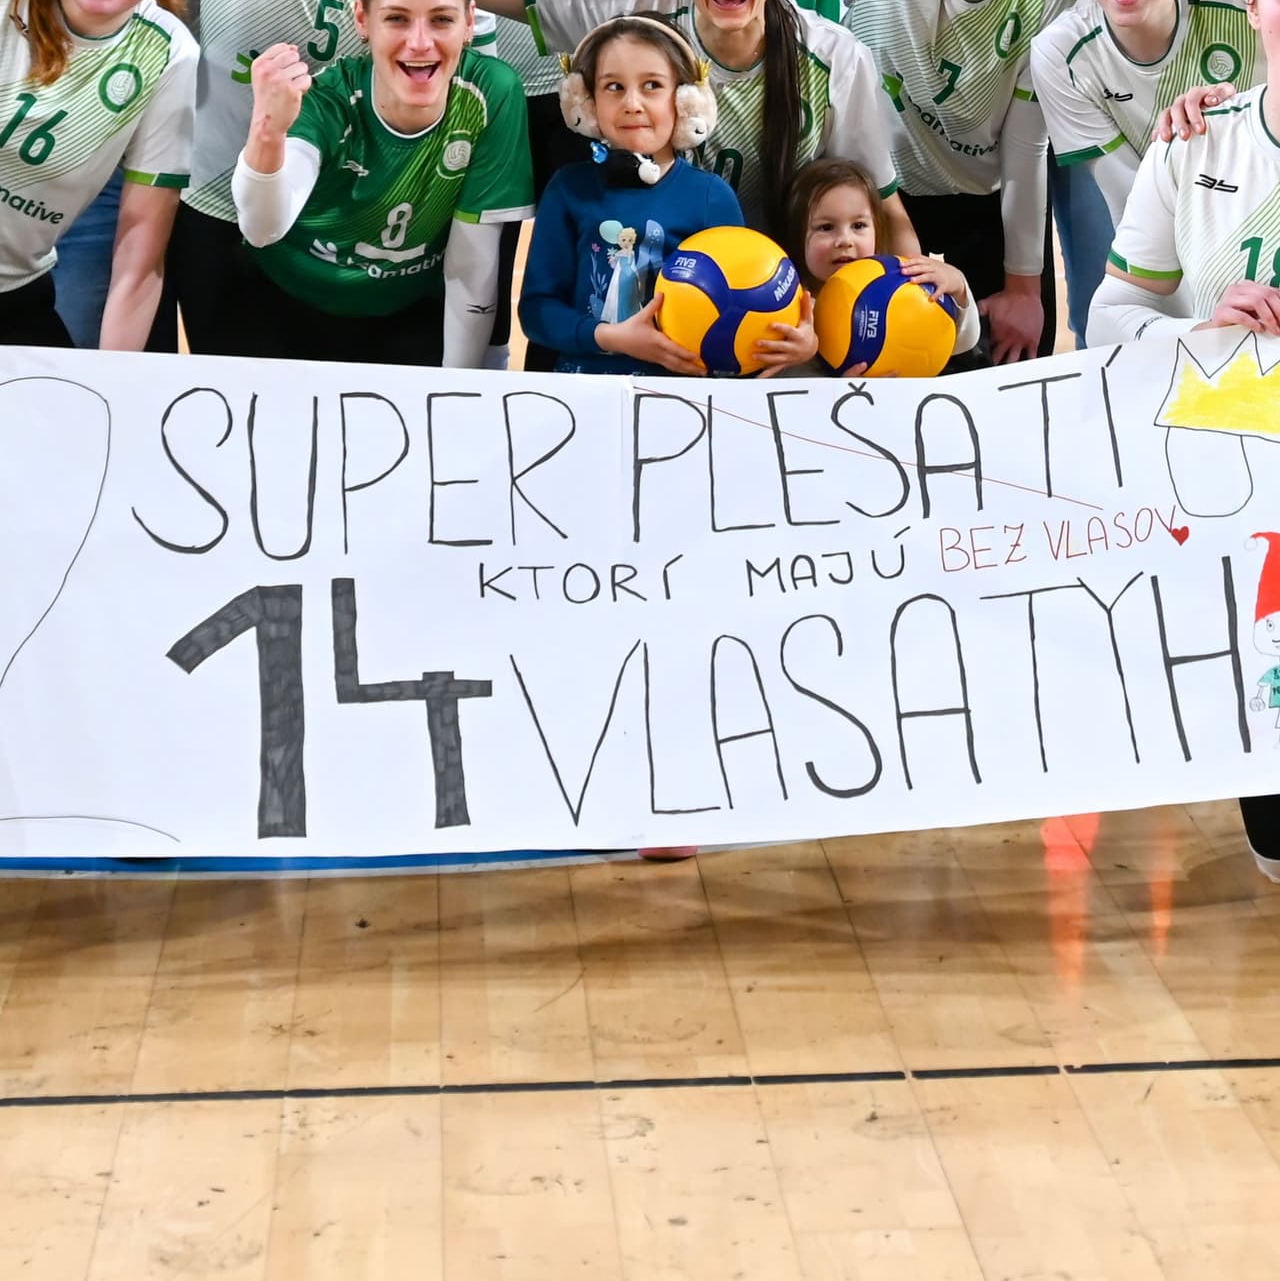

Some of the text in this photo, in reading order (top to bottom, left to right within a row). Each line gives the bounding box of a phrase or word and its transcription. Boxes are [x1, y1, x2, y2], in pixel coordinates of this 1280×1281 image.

[932, 58, 962, 106] 7
[380, 202, 413, 249] 8
[866, 310, 880, 339] FIVB
[131, 342, 1124, 561] SUPER PLEŠATÍ
[477, 505, 1178, 607] KTORÍ MAJÚ BEZ VLASOV
[164, 554, 1252, 840] 14 VLASATYH
